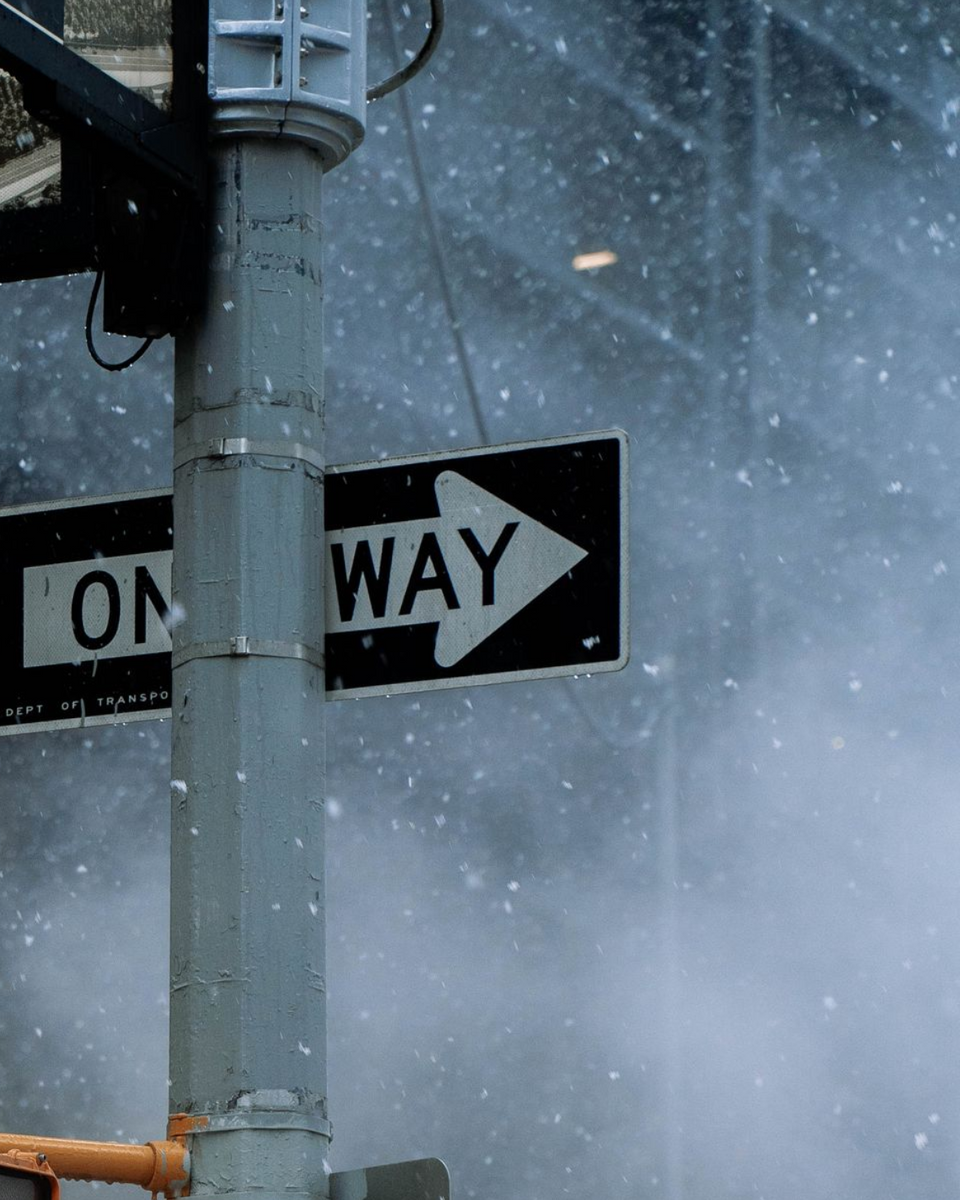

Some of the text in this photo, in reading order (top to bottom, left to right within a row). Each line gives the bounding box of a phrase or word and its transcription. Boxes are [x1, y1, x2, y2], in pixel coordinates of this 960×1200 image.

[71, 521, 520, 650] ON WAY
[5, 690, 169, 718] DEPT OF TRANSPO
